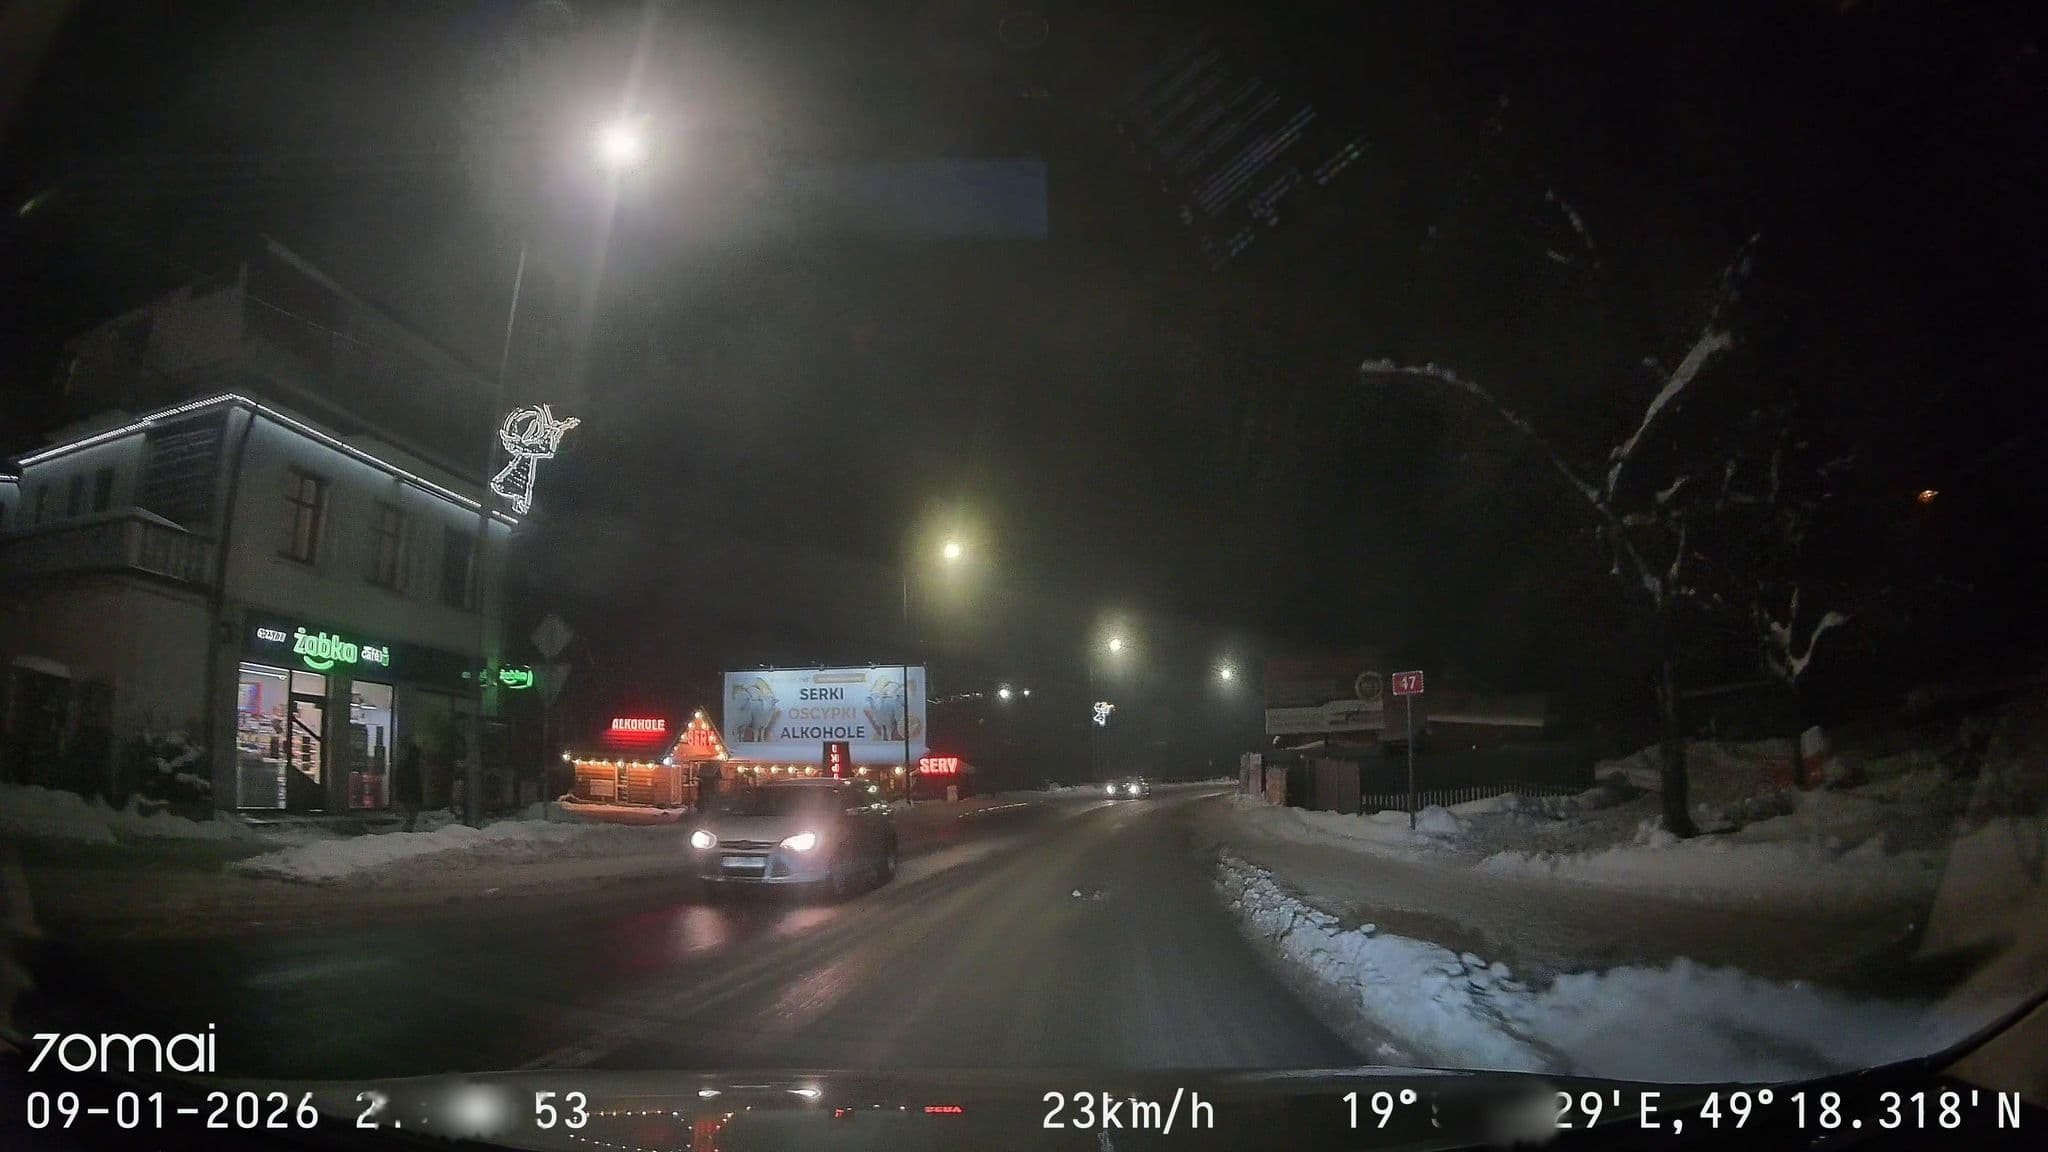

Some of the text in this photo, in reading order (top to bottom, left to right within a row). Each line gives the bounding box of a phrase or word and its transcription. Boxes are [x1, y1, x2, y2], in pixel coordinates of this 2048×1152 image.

[293, 626, 358, 663] żabka
[1401, 675, 1416, 690] 47
[800, 687, 844, 700] SERKI
[788, 706, 857, 720] OSCYPKI
[612, 718, 666, 731] ALKOHOLE
[780, 726, 865, 739] ALKOHOLE
